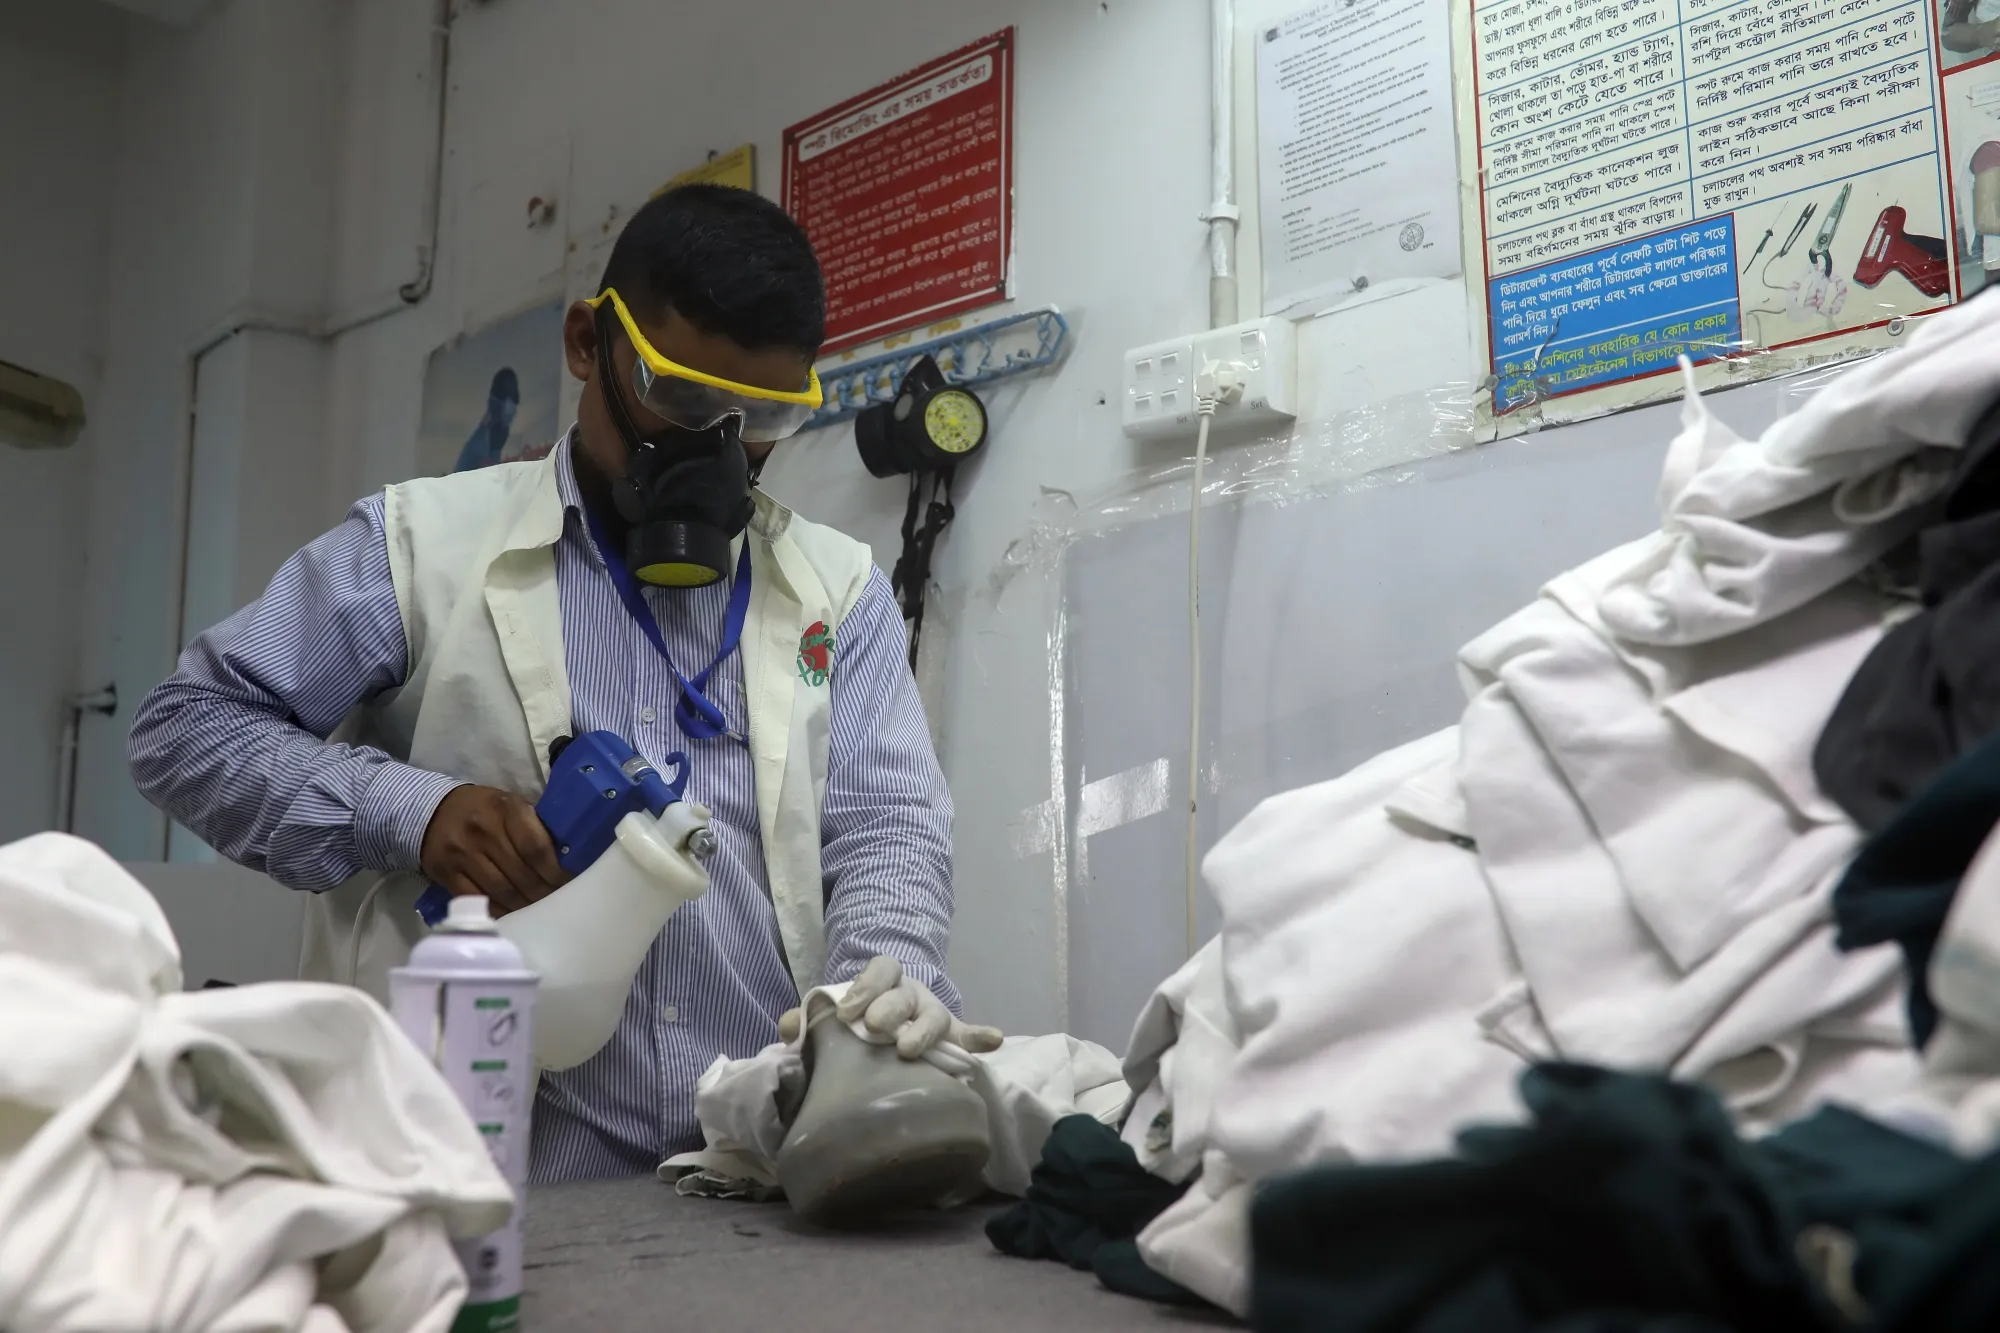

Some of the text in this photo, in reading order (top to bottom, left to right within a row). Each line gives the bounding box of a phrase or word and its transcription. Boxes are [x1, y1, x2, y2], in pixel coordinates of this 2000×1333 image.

[1483, 13, 1497, 26] হাত
[1485, 5, 1618, 61] আপনার ফুসফুসে এবং শরীরে বিভিন্ন
[1486, 12, 1657, 80] করে বিভিন্ন ধরনের রোগ হতে পারে
[1504, 4, 1572, 36] ময়লা বালি ও
[1689, 5, 1762, 37] সিজার, কাটার,
[1690, 2, 1809, 51] রশি দিয়ে বেঁধে রাখুন
[1780, 9, 1834, 34] নীতিমালা
[1487, 88, 1525, 107] সিজার,
[1528, 74, 1565, 93] কাটার,
[1612, 46, 1639, 63] হ্যান্ড
[1642, 34, 1674, 52] ট্যাগ,
[1695, 11, 1915, 91] স্পট রুমে কাজ করার সময় পানি স্প্রে পটে
[1696, 31, 1908, 109] নির্দিষ্ট পরিমান পানি ভরে রাখতে হবে
[1489, 50, 1672, 122] খোলা থাকলে তা পড়ে হাত-পা বা শরীরে
[1490, 70, 1664, 137] কোন অংশ কেটে যেতে পারে
[1697, 61, 1919, 137] কাজ শুরু করার পূর্বে অবশ্যই বৈদ্যুতিক
[1698, 77, 1920, 153] লাইন সঠিকভাবে আছে কিনা পরীক্ষা
[1492, 89, 1675, 154] স্পট রুমে কাজ করার সময় পানি স্প্রে পটে
[1493, 112, 1650, 169] নির্দিষ্ট পরিমান পানি না থাকলে
[1494, 118, 1670, 181] মেশিন চালালে বৈদ্যুতিক ঘটতে পারে
[1496, 144, 1679, 208] মেশিনের বৈদ্যুতিক কানেকশন লুজ
[1699, 146, 1751, 168] করে নিন
[1702, 119, 1923, 193] চলাচলের পথ অবশ্যই সব সময় বাঁধা
[1496, 206, 1532, 223] থাকলে
[1536, 196, 1560, 210] অগ্নি
[1605, 173, 1639, 190] ঘটতে
[1644, 163, 1672, 178] পারে
[1497, 191, 1683, 252] চলাচলের পথ বা বাঁধা থাকলে বিপদের
[1703, 187, 1749, 210] মুক্ত রাখুন
[1498, 253, 1521, 266] সময়
[1583, 228, 1609, 241] সময়
[1612, 218, 1637, 235] ঝুঁকি
[1641, 209, 1675, 225] বাড়ায়
[1500, 226, 1726, 297] ডিটারজেন্ট ব্যবহারের পূর্বে সেফটি ডাটা শিট পড়ে
[1501, 300, 1516, 313] নিন
[1519, 296, 1537, 307] এবং
[1539, 285, 1572, 302] আপনার
[1575, 277, 1601, 292] শরীরে
[1604, 262, 1652, 285] ডিটারজেন্ট
[1654, 255, 1685, 271] লাগলে
[1503, 275, 1677, 328] পানি দিয়ে ধুয়ে ফেলুন এবং সব ক্ষেত্রে
[1504, 325, 1548, 345] পরামর্শ নিন
[1541, 313, 1726, 369] মেশিনের ব্যবহারিক যে কোন প্রকার
